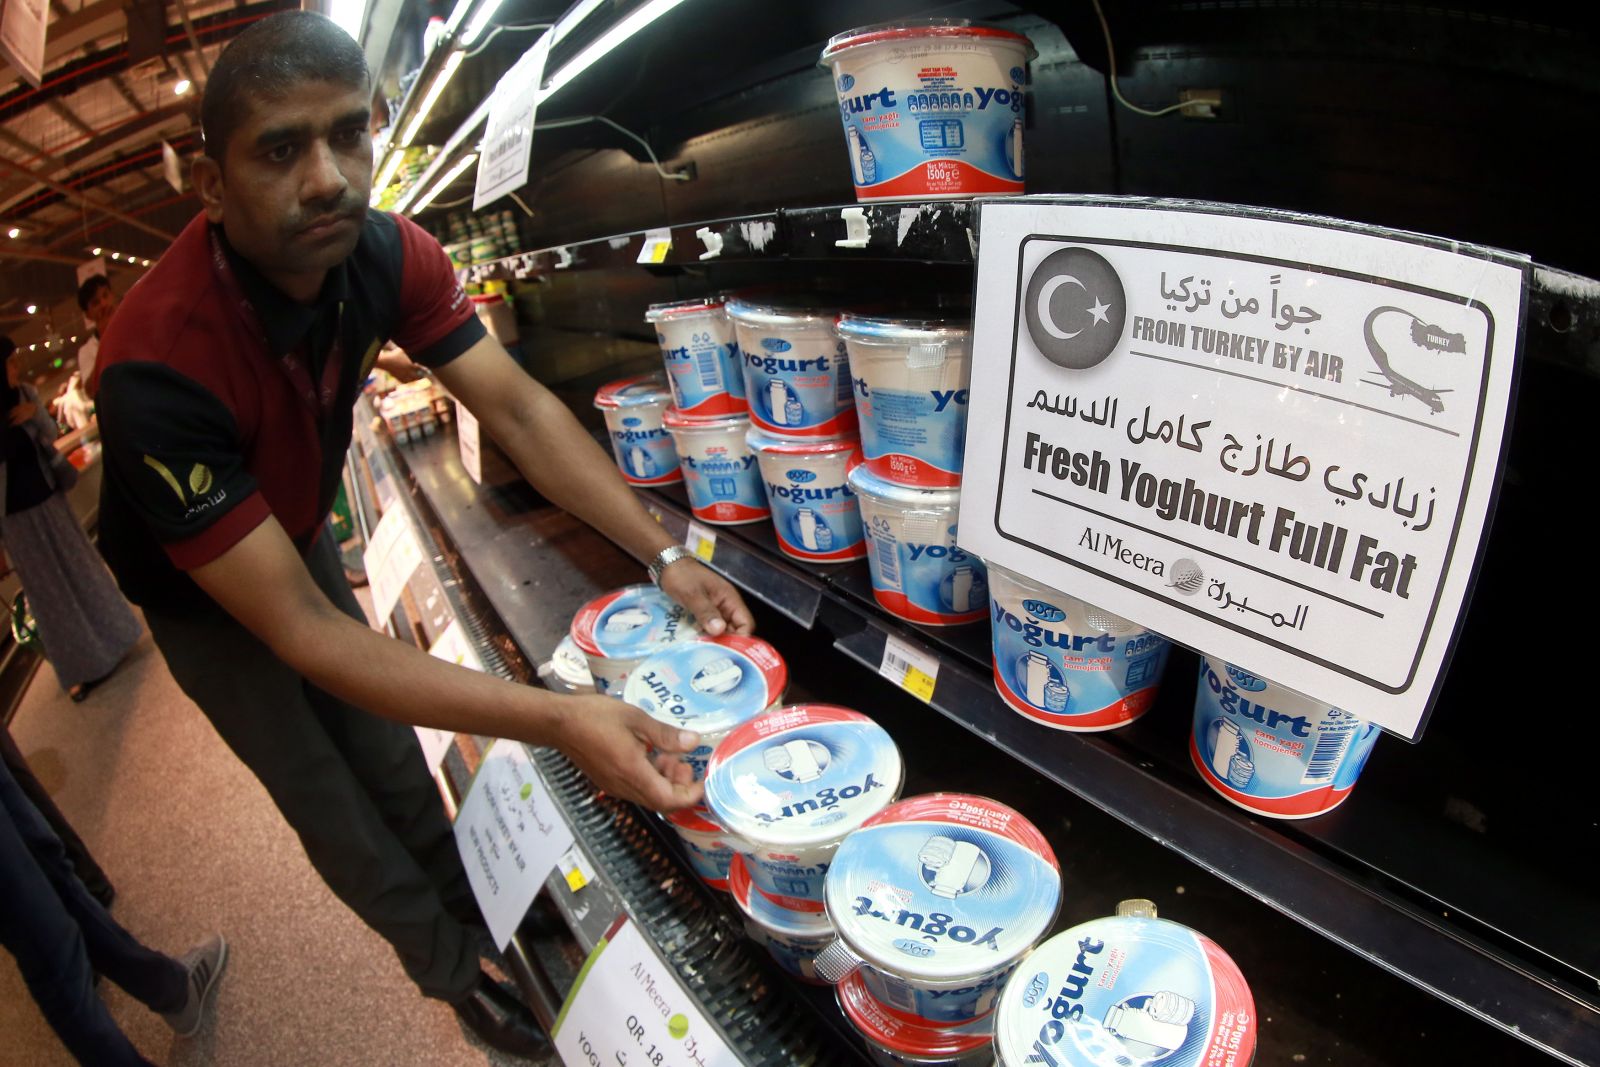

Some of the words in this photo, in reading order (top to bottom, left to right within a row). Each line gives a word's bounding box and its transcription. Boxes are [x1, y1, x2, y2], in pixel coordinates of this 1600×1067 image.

[1160, 271, 1212, 313] تركيا
[1220, 288, 1260, 320] من
[1270, 273, 1323, 336] جواً
[1132, 315, 1187, 348] FROM
[1190, 325, 1270, 365] TURKEY
[1271, 341, 1303, 373] BY
[1303, 349, 1345, 384] AIR
[1426, 333, 1450, 347] TURKEY
[743, 352, 830, 375] yoğurt
[1026, 389, 1119, 429] الدسم
[1126, 405, 1212, 453] كامل
[1219, 432, 1312, 482] طازج
[767, 483, 855, 504] yoğurt
[1023, 431, 1111, 495] Fresh
[1120, 457, 1266, 546] Yoghurt
[1268, 506, 1349, 575] Full
[1349, 533, 1419, 600] Fat
[1323, 464, 1437, 532] زبادي
[905, 538, 967, 562] yoğ
[1078, 526, 1101, 552] Al
[1102, 533, 1165, 578] Meera
[660, 604, 685, 643] oğurt
[992, 599, 1116, 653] yoğurt
[1027, 602, 1059, 619] DOST
[1206, 577, 1310, 632] الميرة
[1063, 655, 1084, 663] tam
[1087, 655, 1113, 665] yağlı
[1063, 663, 1113, 672] homojenize
[1200, 656, 1312, 738] yoğurt
[1252, 737, 1303, 758] homojenize
[1254, 728, 1276, 742] tam
[1278, 738, 1305, 751] yağlı
[754, 772, 885, 823] yoğurt
[851, 895, 1004, 952] yoğurt
[903, 943, 931, 956] DOST
[643, 971, 672, 1018] Meera
[1023, 936, 1105, 1067] yoğurt
[1026, 973, 1047, 1006] DOST
[626, 1015, 645, 1046] QR.
[645, 1044, 664, 1067] 18
